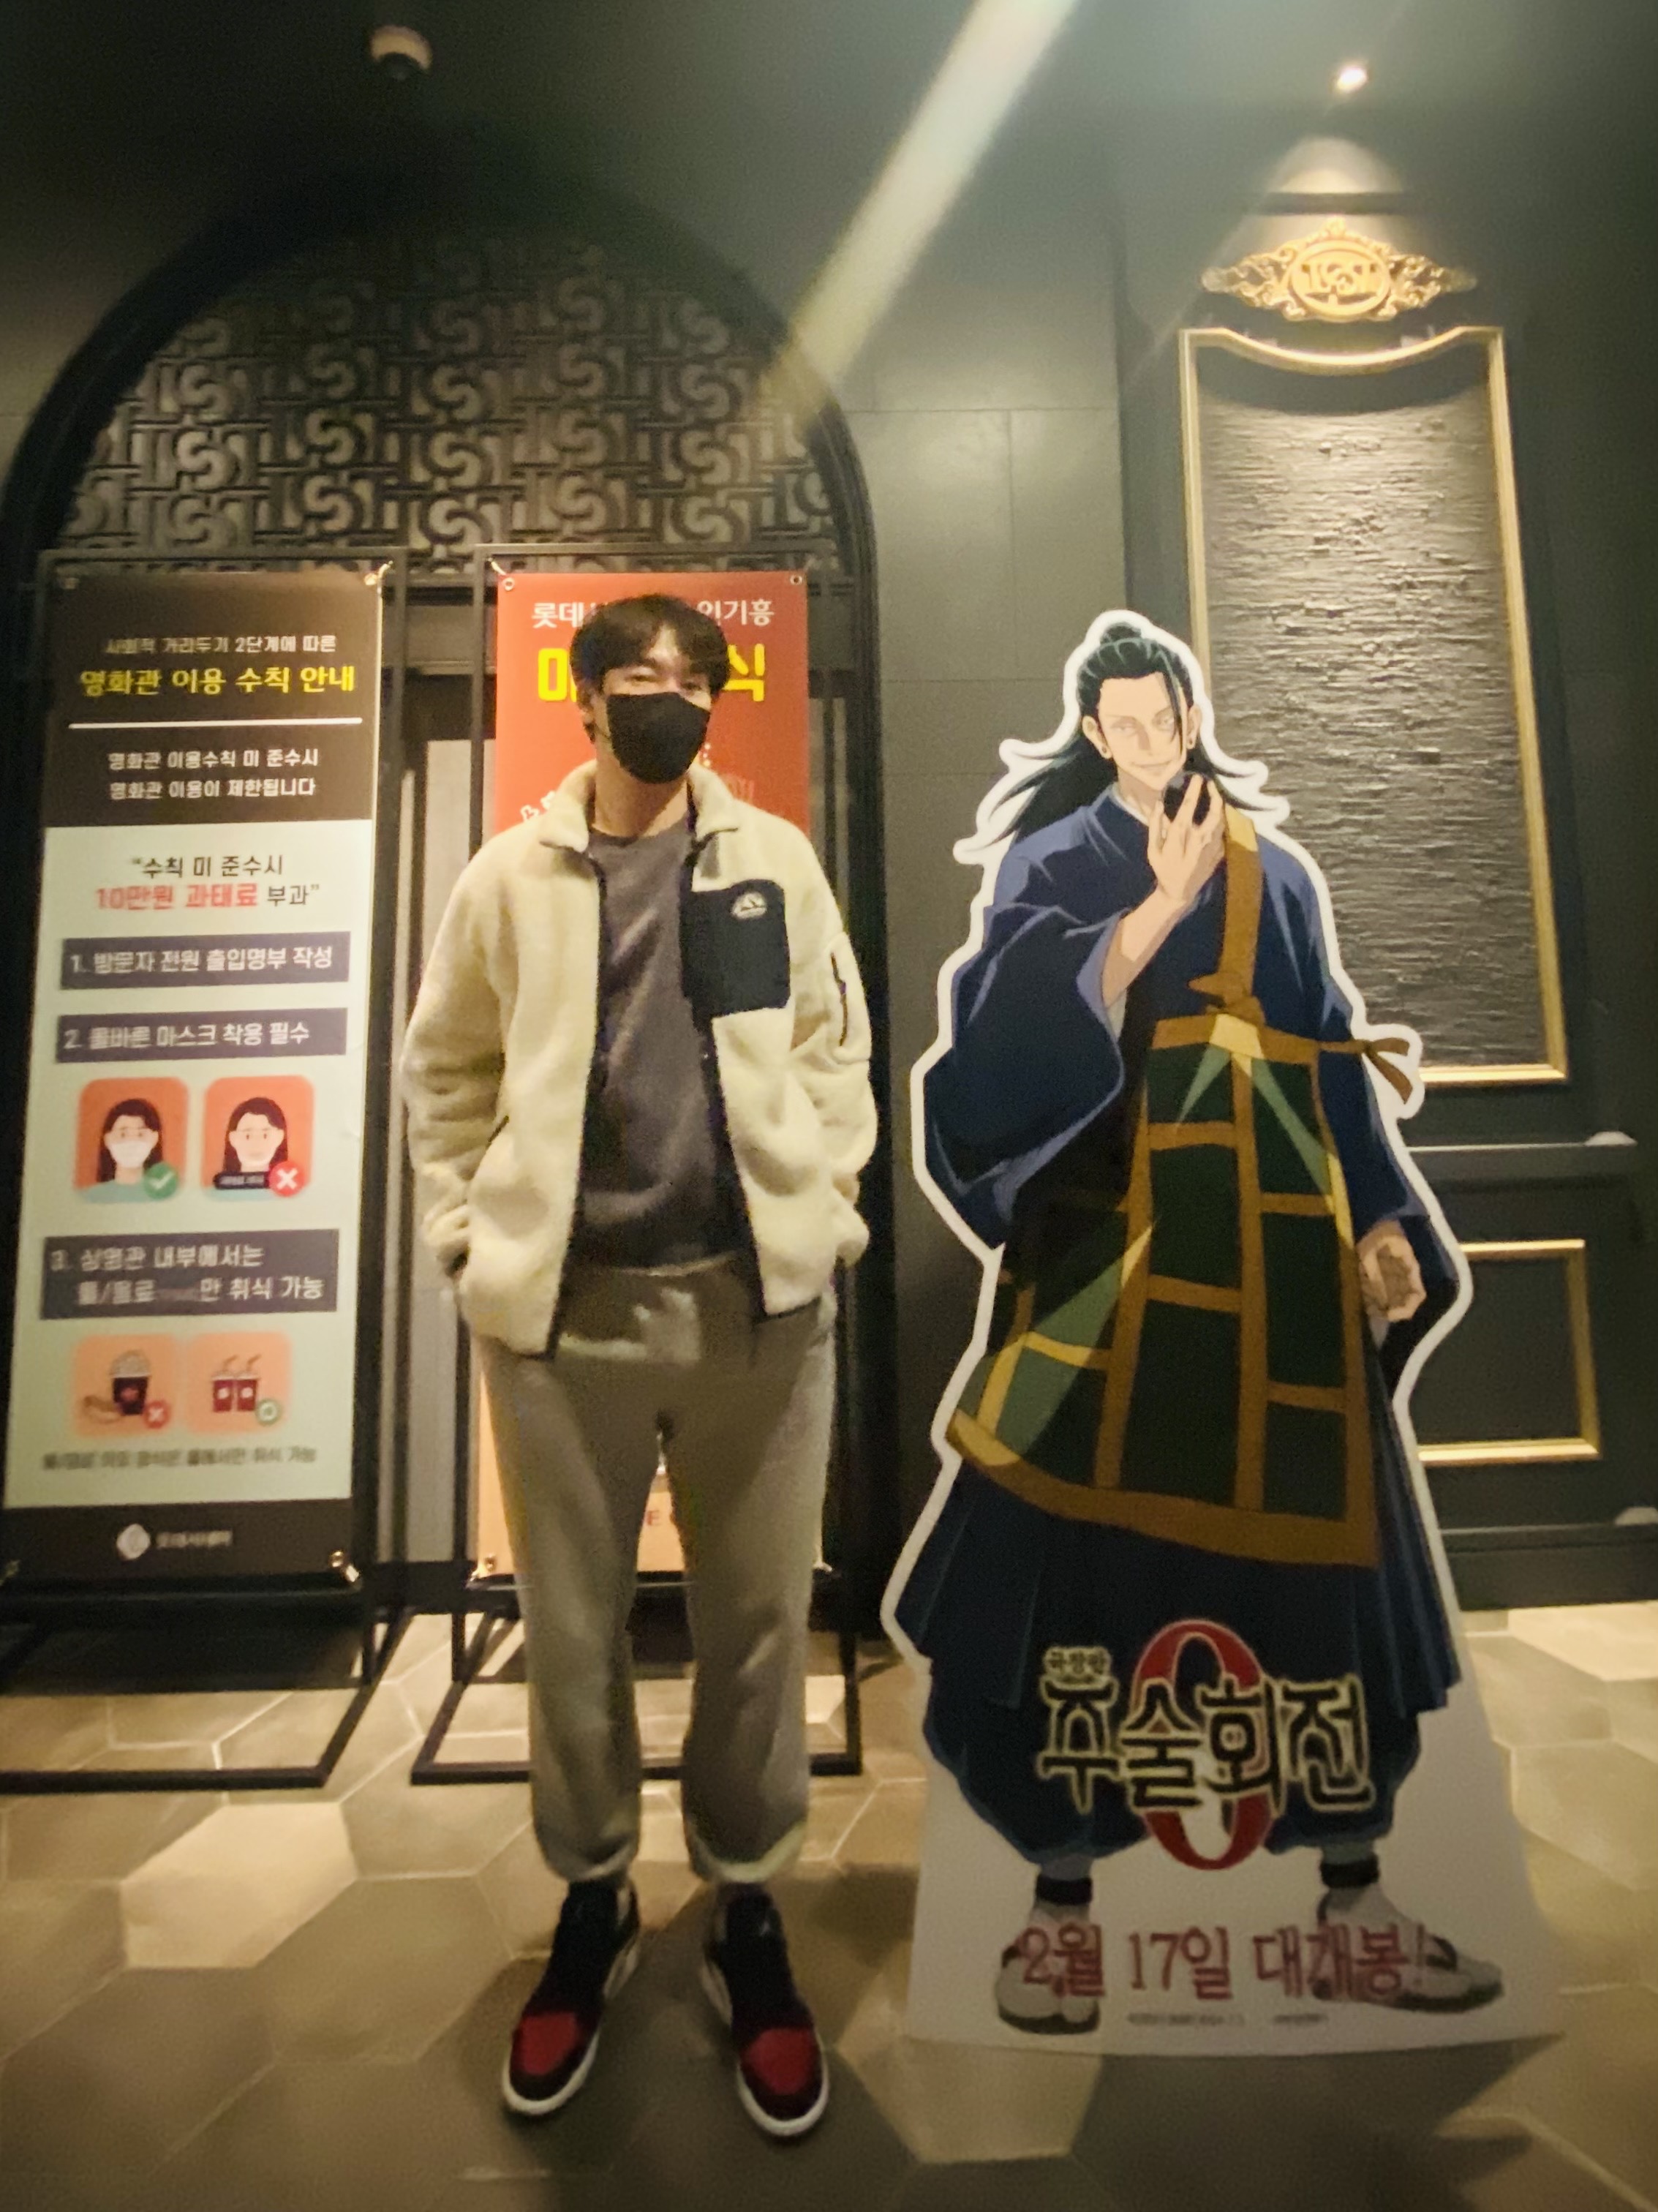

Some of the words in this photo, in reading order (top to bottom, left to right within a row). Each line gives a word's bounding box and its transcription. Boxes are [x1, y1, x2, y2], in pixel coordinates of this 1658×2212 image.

[162, 636, 229, 654] 거리두기
[235, 635, 295, 652] 2단계에
[303, 634, 336, 652] 따른
[80, 669, 162, 697] 영화관
[171, 667, 226, 695] 이용
[235, 666, 290, 693] 수칙
[300, 665, 355, 692] 안내
[108, 751, 162, 771] 영화관
[167, 749, 236, 769] 이용수칙
[243, 749, 260, 767] 미
[266, 748, 319, 768] 준수시
[109, 780, 162, 801] 영화관
[168, 779, 220, 800] 이용이
[227, 777, 316, 797] 제한됩니다
[193, 857, 211, 877] 미
[221, 854, 283, 877] 준수시
[96, 885, 173, 911] 10만원
[186, 883, 258, 908] 과태료
[93, 952, 156, 975] 방문자
[161, 949, 200, 972] 전원
[206, 947, 287, 971] 출입명부
[293, 946, 334, 970] 작성
[156, 1024, 218, 1048] 마스크
[223, 1023, 263, 1046] 착용
[268, 1021, 310, 1045] 필수
[80, 1246, 146, 1272] 상영관
[153, 1244, 265, 1269] 내부에서는
[229, 1275, 271, 1301] 취식
[280, 1274, 325, 1300] 가능
[1037, 1674, 1376, 1817] 주술회전
[1022, 1924, 1105, 1998] 2월
[1128, 1926, 1233, 2000] 17일
